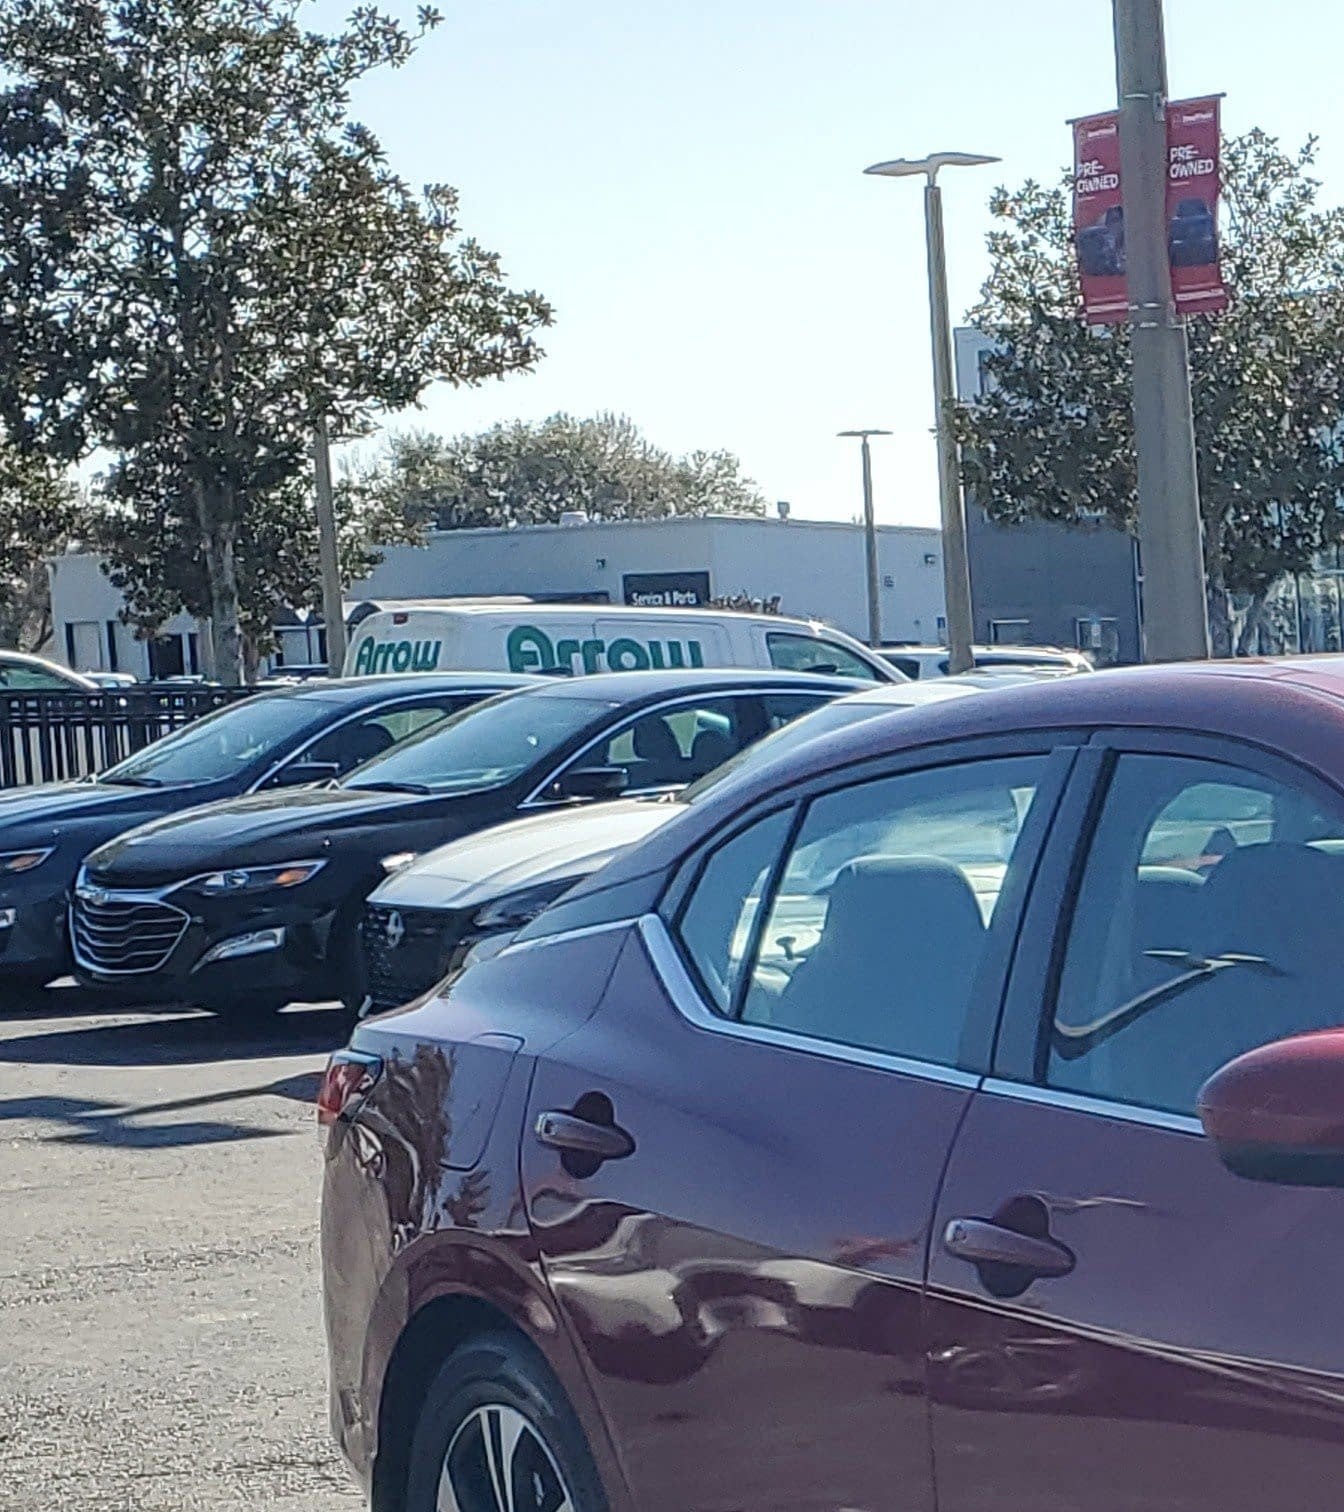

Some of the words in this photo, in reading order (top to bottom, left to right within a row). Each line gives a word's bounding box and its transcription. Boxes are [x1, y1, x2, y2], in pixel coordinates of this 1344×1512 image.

[1169, 158, 1214, 178] OWNED
[354, 636, 442, 677] Arrow
[506, 624, 704, 677] Arrow
